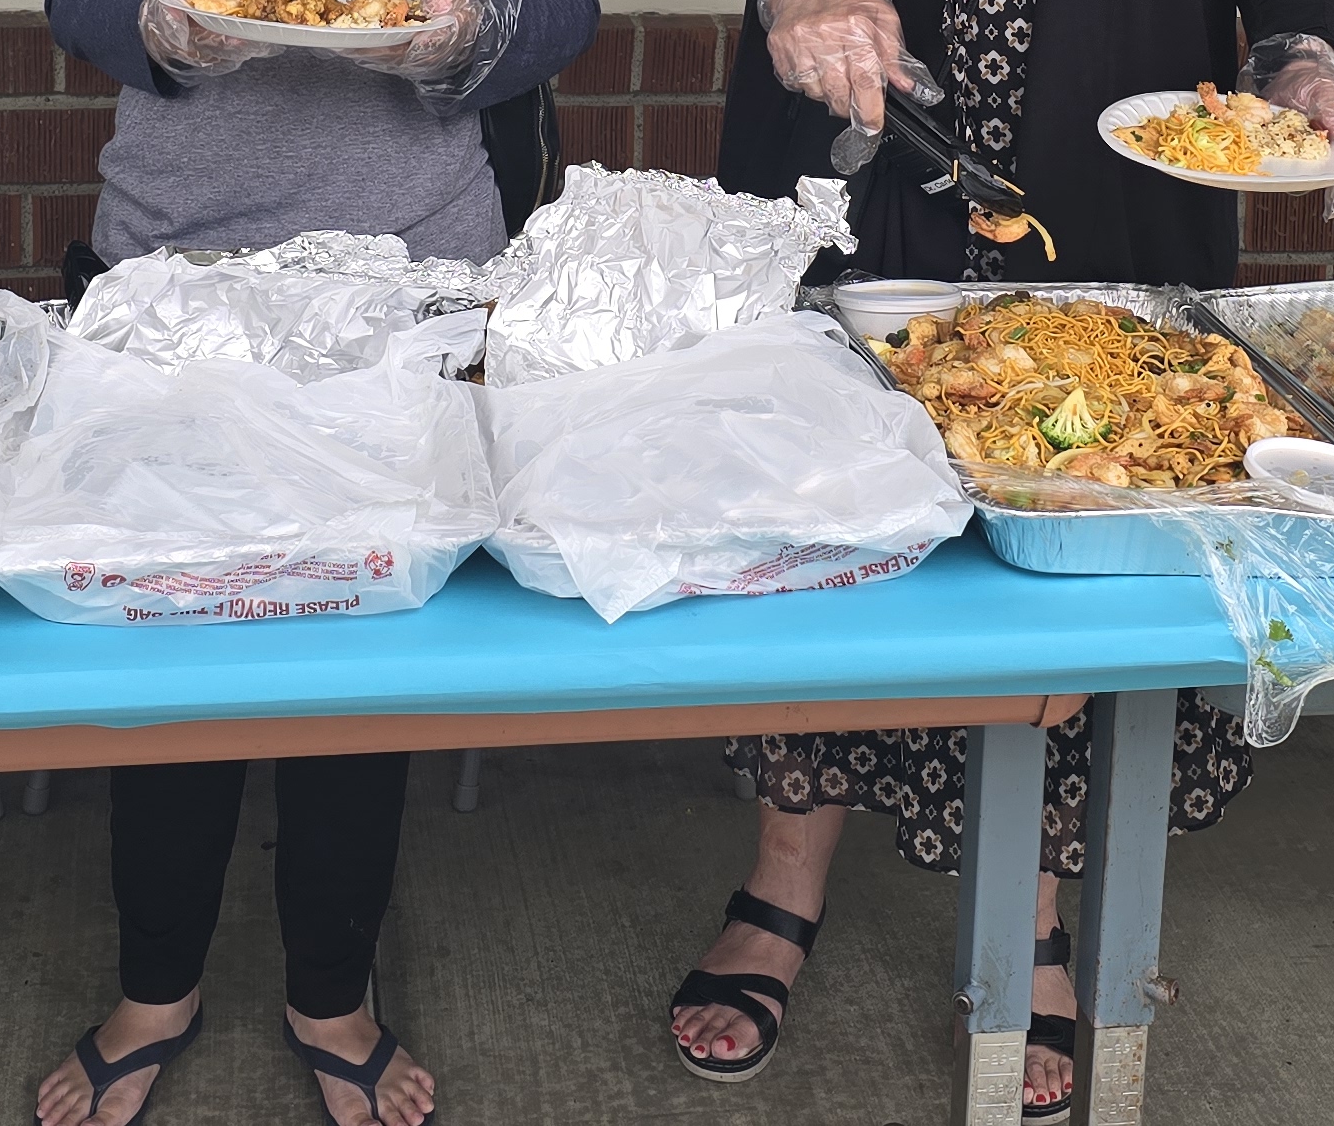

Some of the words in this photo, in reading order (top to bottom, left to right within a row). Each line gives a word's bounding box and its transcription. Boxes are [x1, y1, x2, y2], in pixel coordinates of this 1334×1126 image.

[858, 554, 919, 579] PLEASE
[214, 598, 290, 619] RECYCLE
[295, 594, 360, 614] PLEASE
